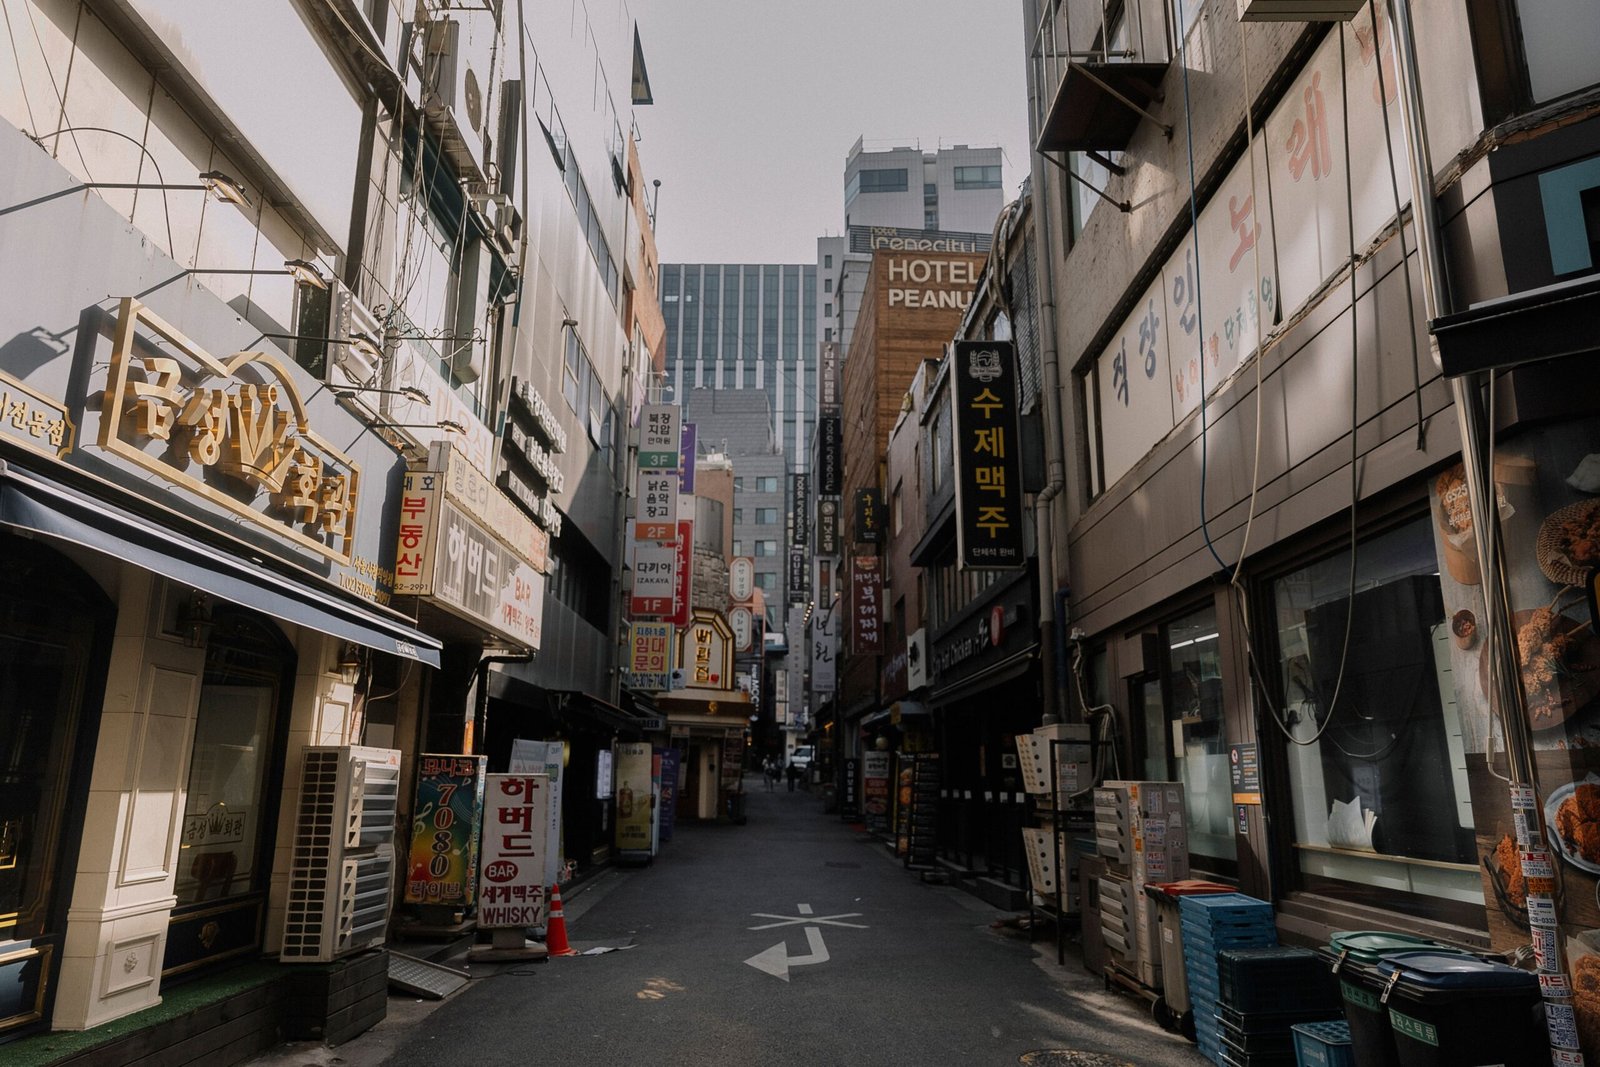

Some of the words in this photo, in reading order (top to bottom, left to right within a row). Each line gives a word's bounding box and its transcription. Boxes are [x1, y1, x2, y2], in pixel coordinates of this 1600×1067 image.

[888, 259, 978, 284] HOTEL
[888, 289, 974, 309] PEANU
[1113, 248, 1197, 408] 직장인
[132, 357, 229, 466] 금성
[648, 425, 671, 435] 지압
[650, 455, 669, 466] 3F
[971, 388, 1010, 539] 수제맥주
[648, 480, 670, 491] 낡은
[647, 494, 669, 505] 음악
[396, 497, 426, 577] 부동산
[647, 528, 666, 538] 2F
[448, 522, 499, 598] 하버드
[637, 562, 672, 574] 다끼야
[515, 576, 531, 602] BAR
[643, 600, 662, 612] 1F
[859, 585, 879, 644] 부대찌개
[636, 637, 665, 653] 임대
[635, 656, 665, 672] 문의
[498, 777, 540, 858] 하버드
[429, 784, 458, 878] 7080
[488, 864, 516, 879] BAR
[482, 885, 544, 904] 세계맥주
[483, 907, 542, 925] WHISKY
